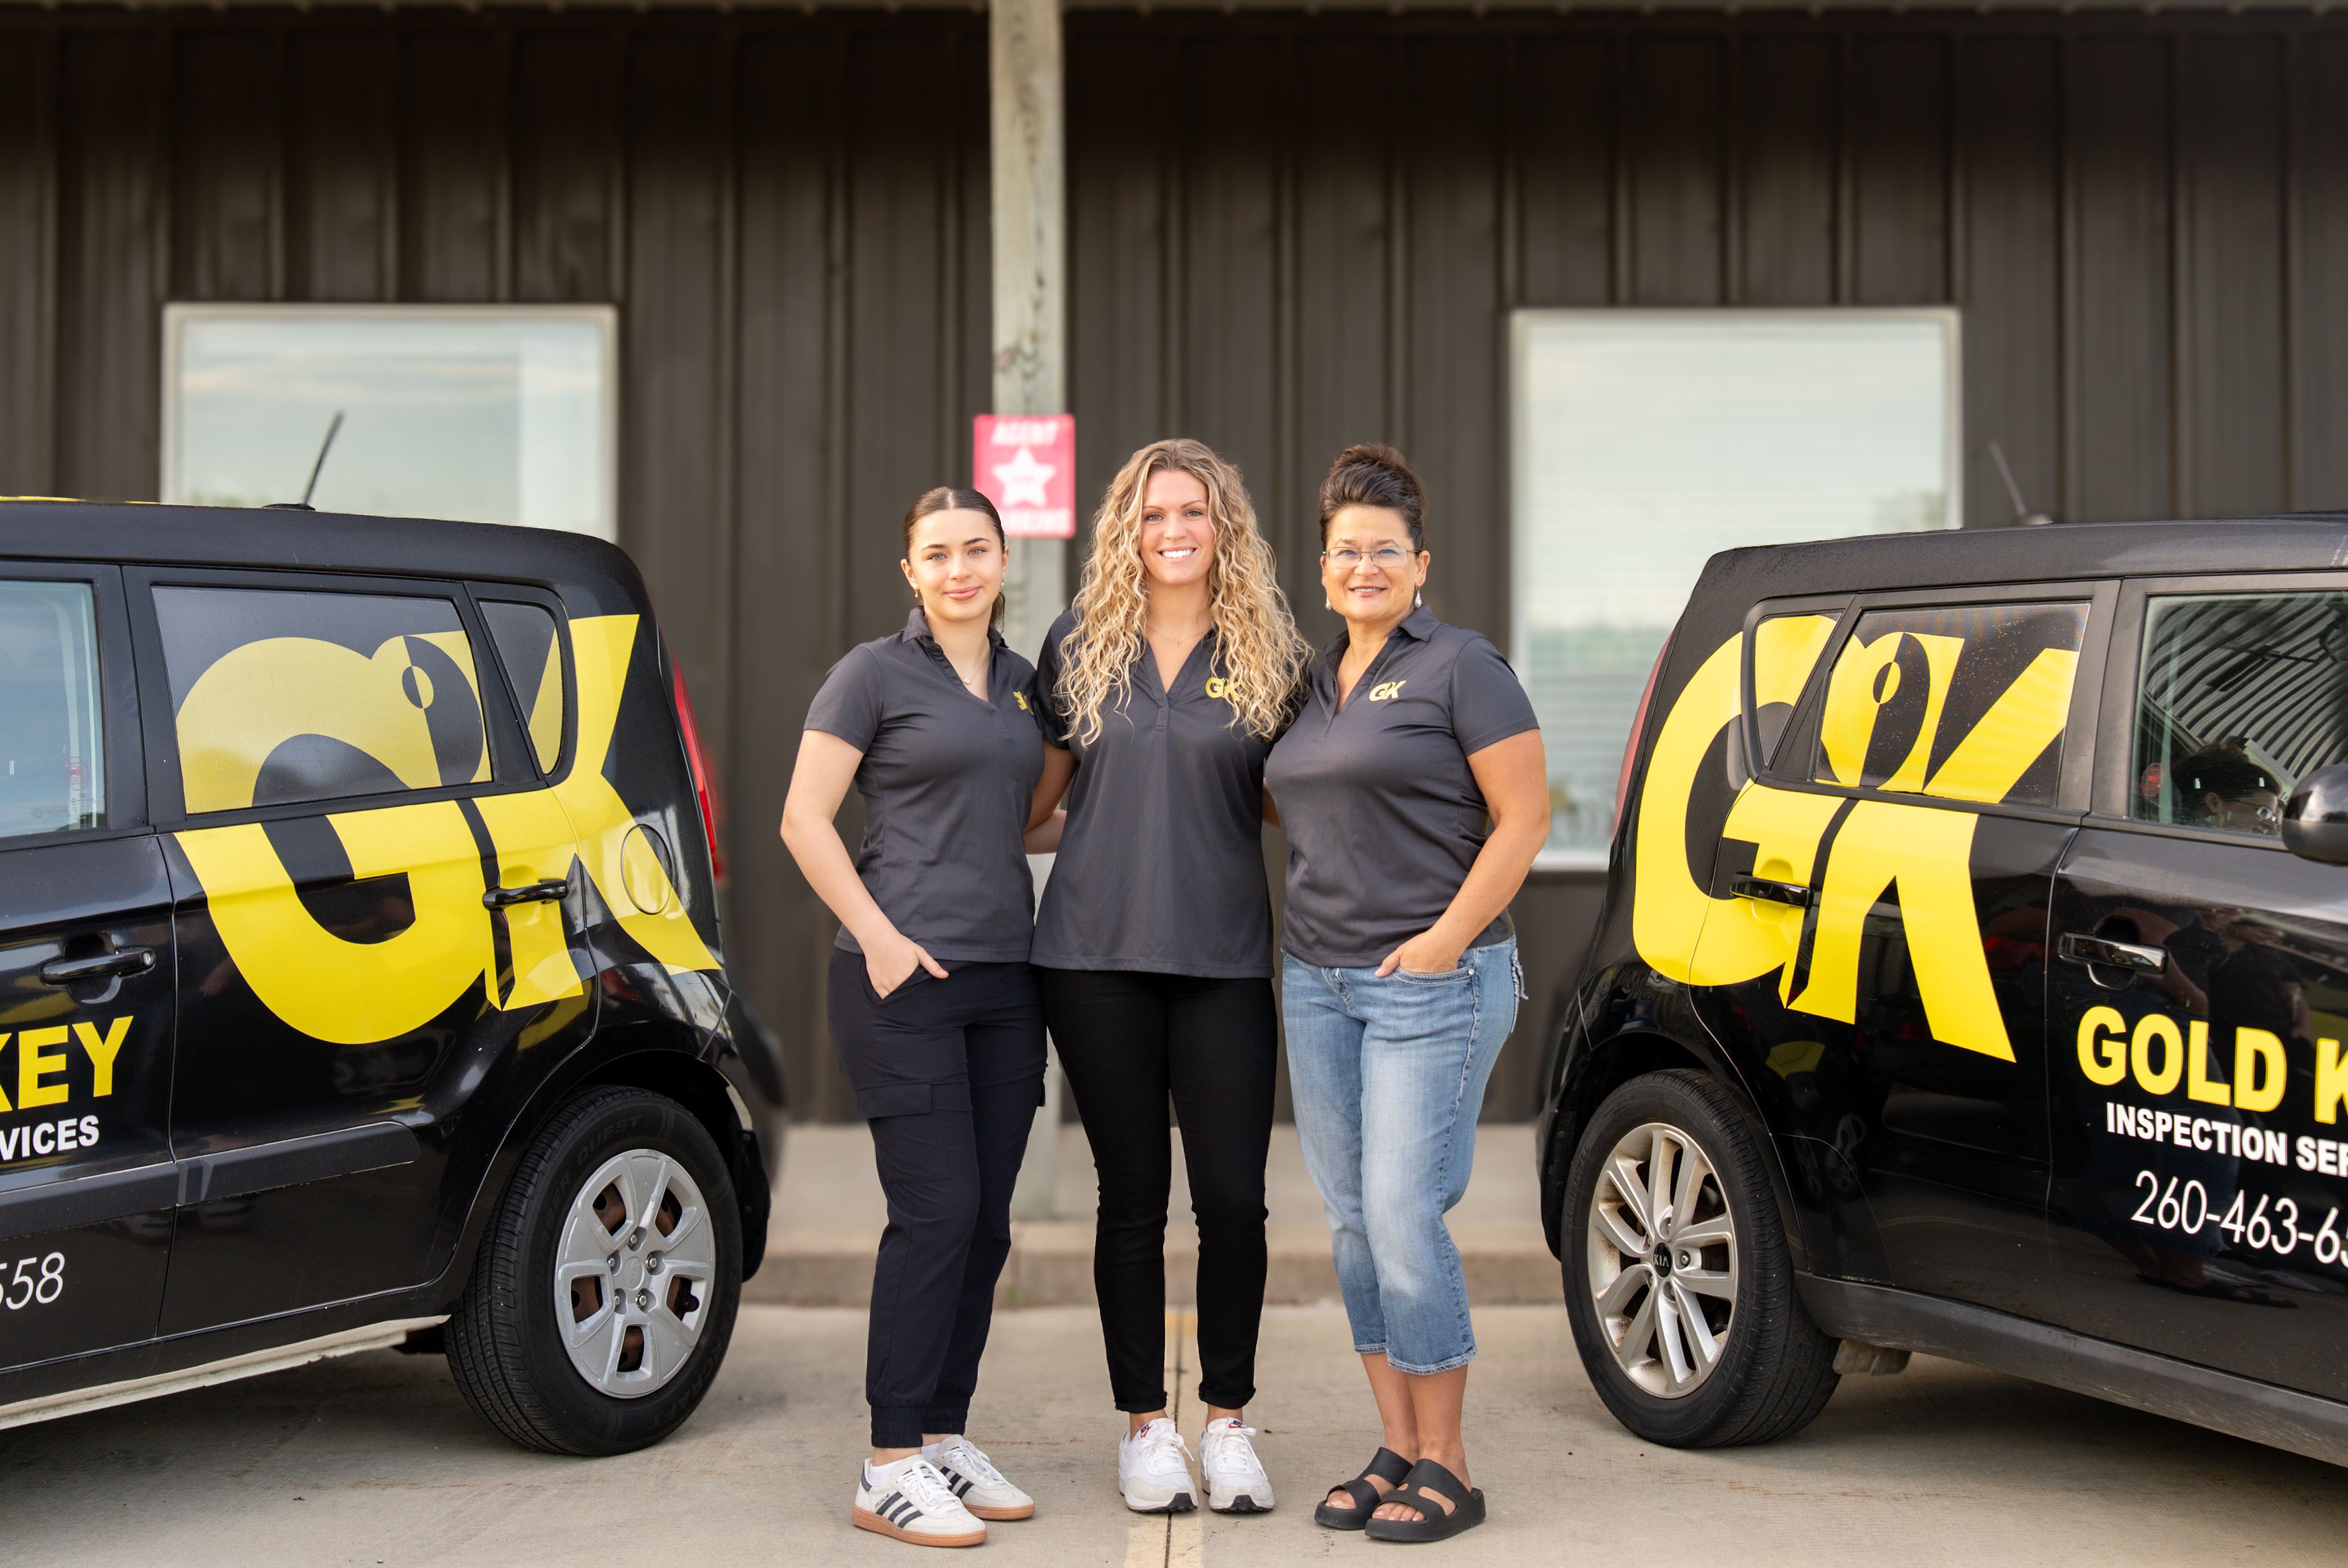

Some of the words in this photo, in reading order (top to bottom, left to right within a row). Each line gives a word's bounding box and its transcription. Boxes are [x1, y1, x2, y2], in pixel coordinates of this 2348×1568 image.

[1369, 680, 1406, 702] GK
[0, 1016, 134, 1112] EY
[2077, 1005, 2287, 1113] GOLD
[0, 1114, 99, 1161] VICES
[2107, 1102, 2288, 1166] INSPECTION
[0, 1251, 65, 1310] 58
[1653, 1254, 1669, 1267] KIA
